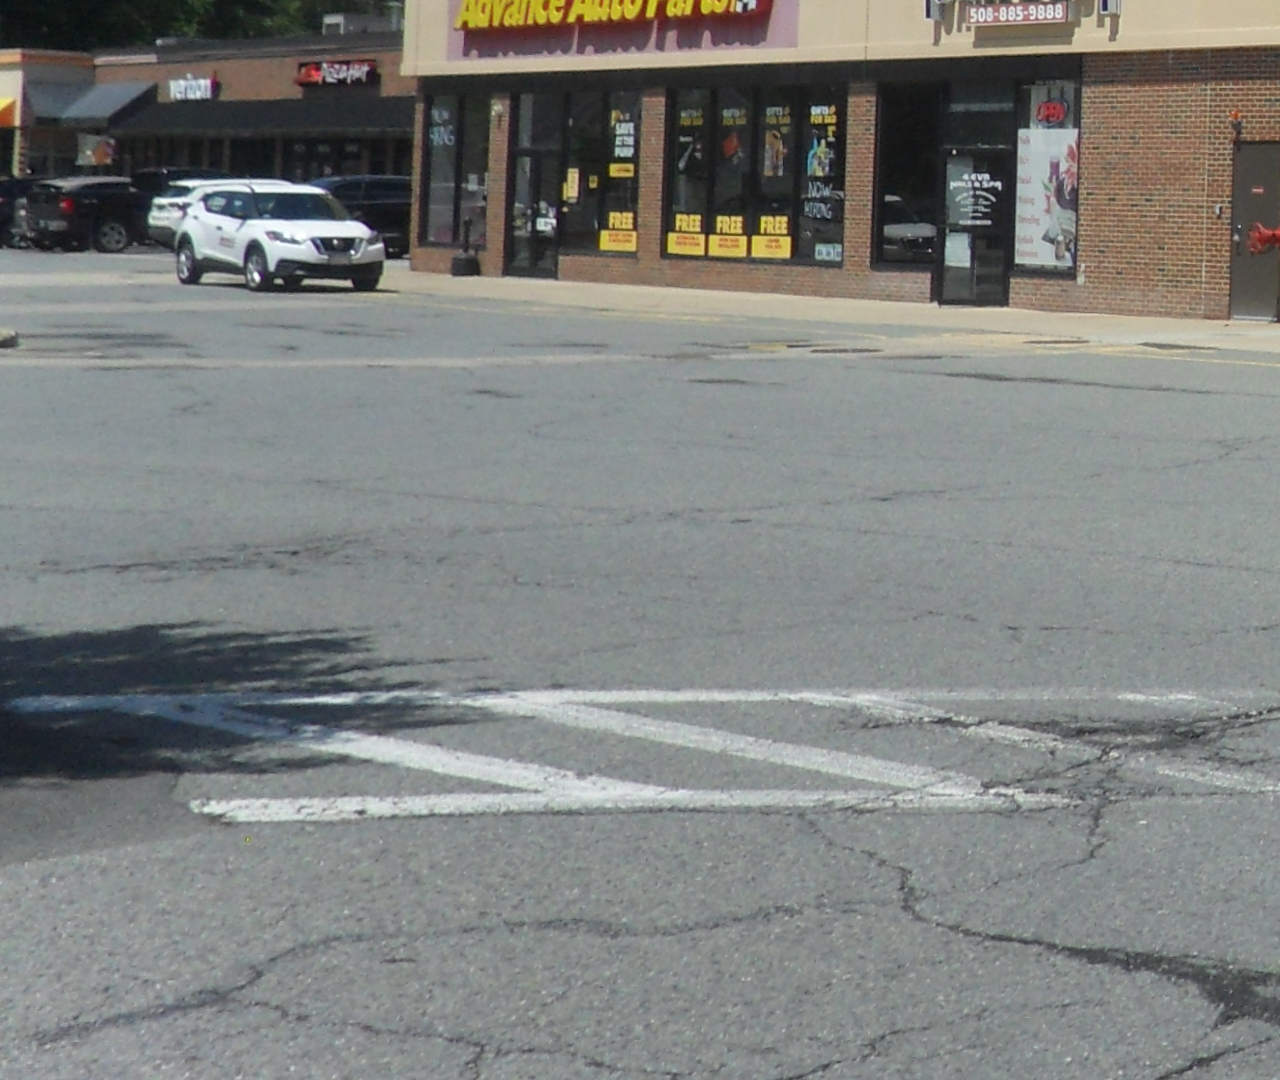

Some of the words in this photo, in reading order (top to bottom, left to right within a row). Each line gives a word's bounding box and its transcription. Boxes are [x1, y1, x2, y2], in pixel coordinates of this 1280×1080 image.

[969, 3, 1064, 22] 508-885-9888
[808, 180, 833, 199] NOW
[609, 211, 634, 230] FREE
[675, 214, 702, 232] FREE
[716, 215, 743, 234] FREE
[760, 215, 789, 235] FREE
